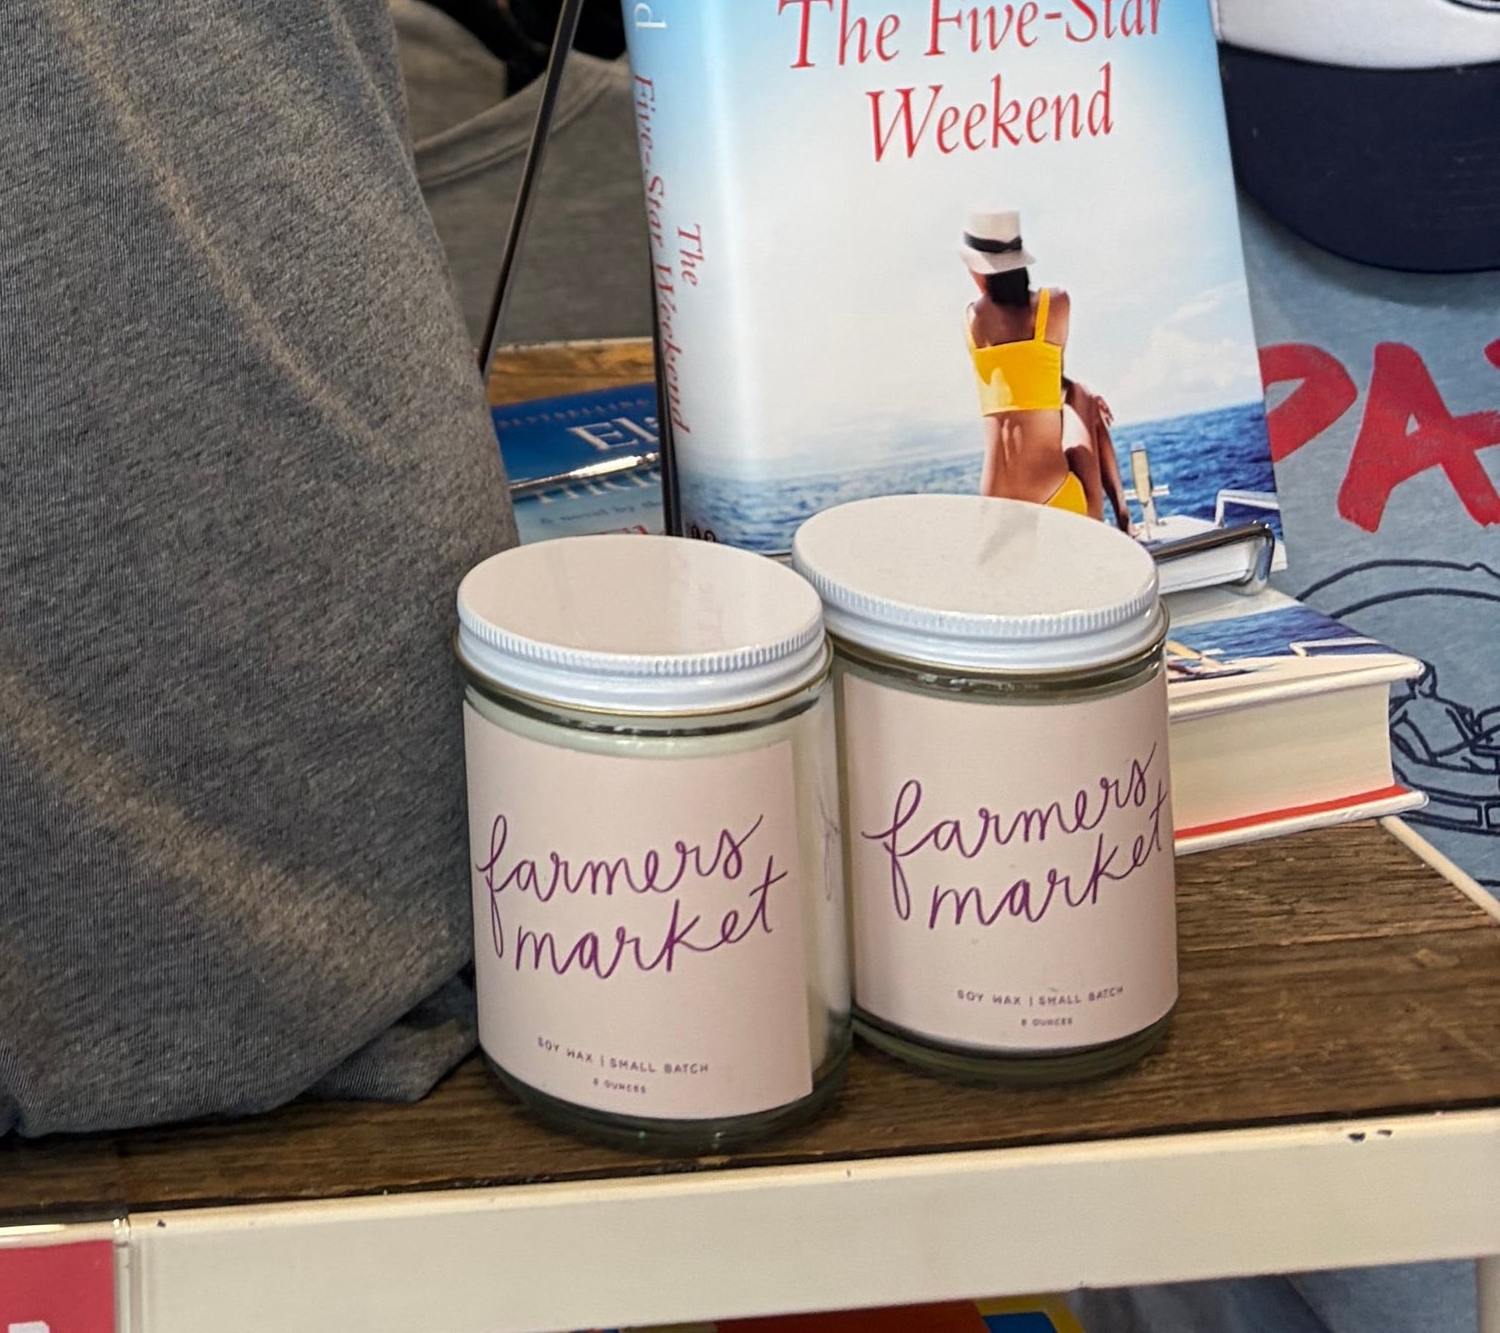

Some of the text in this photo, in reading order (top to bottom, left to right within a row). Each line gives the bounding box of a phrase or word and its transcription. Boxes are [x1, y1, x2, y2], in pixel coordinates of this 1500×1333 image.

[866, 61, 1114, 162] Weekend
[633, 73, 690, 434] Five-Star Weekend
[677, 223, 705, 287] The
[861, 741, 1157, 921] farmers
[928, 778, 1169, 930] market
[476, 814, 764, 958] farmers
[516, 855, 788, 979] market
[957, 986, 1124, 1006] SOY WAX SMALL BATCH
[1032, 1017, 1073, 1026] OUNCES
[537, 1036, 709, 1075] SOY WAX SMALL BATCH
[603, 1079, 646, 1094] OUNCES
